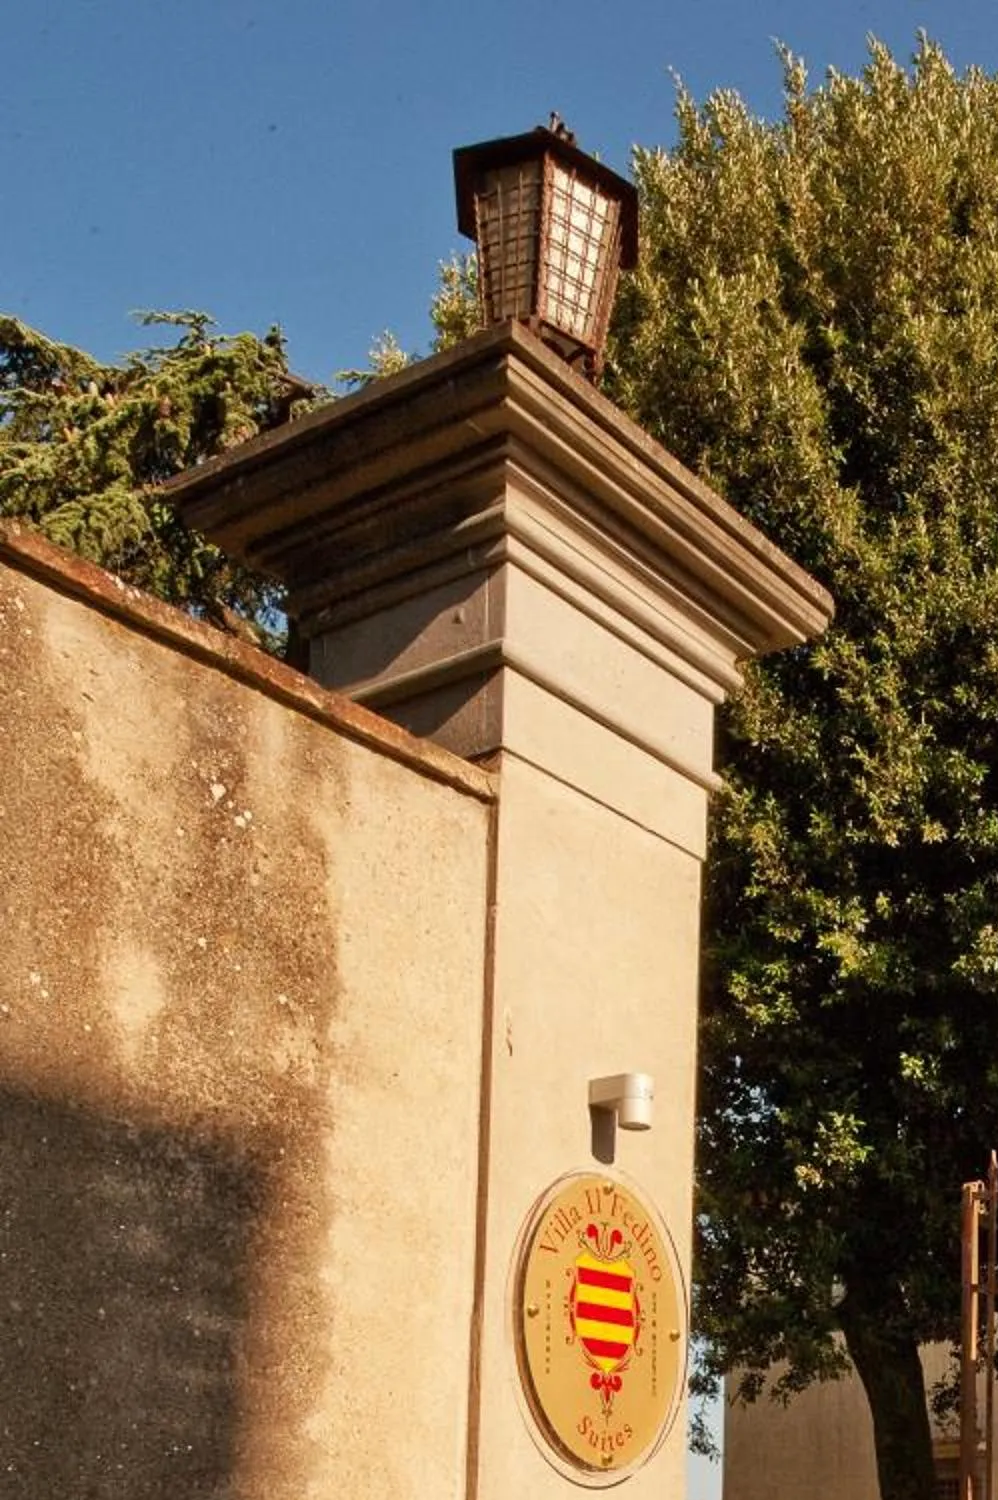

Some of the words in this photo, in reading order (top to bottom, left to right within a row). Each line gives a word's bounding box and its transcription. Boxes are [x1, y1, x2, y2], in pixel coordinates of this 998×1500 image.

[540, 1206, 582, 1255] Villa
[611, 1193, 662, 1282] Fedino
[576, 1415, 632, 1452] Suites
